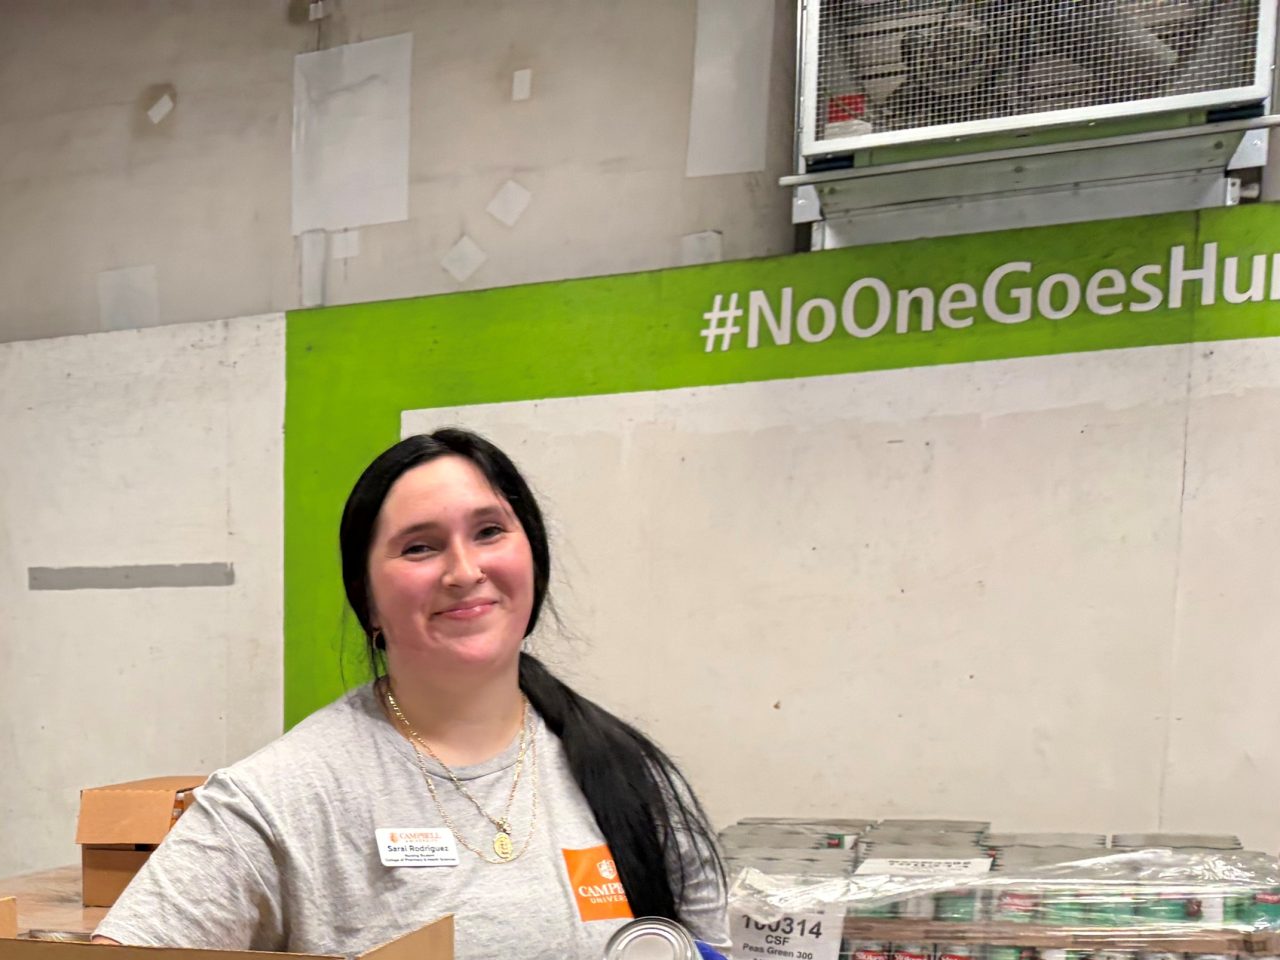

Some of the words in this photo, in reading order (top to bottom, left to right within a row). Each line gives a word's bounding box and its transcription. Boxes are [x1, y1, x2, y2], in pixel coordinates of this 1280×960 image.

[409, 845, 448, 853] Rodriguez
[765, 934, 790, 946] CSF
[742, 943, 765, 953] Peas
[766, 946, 794, 958] Green
[796, 951, 813, 960] 300
